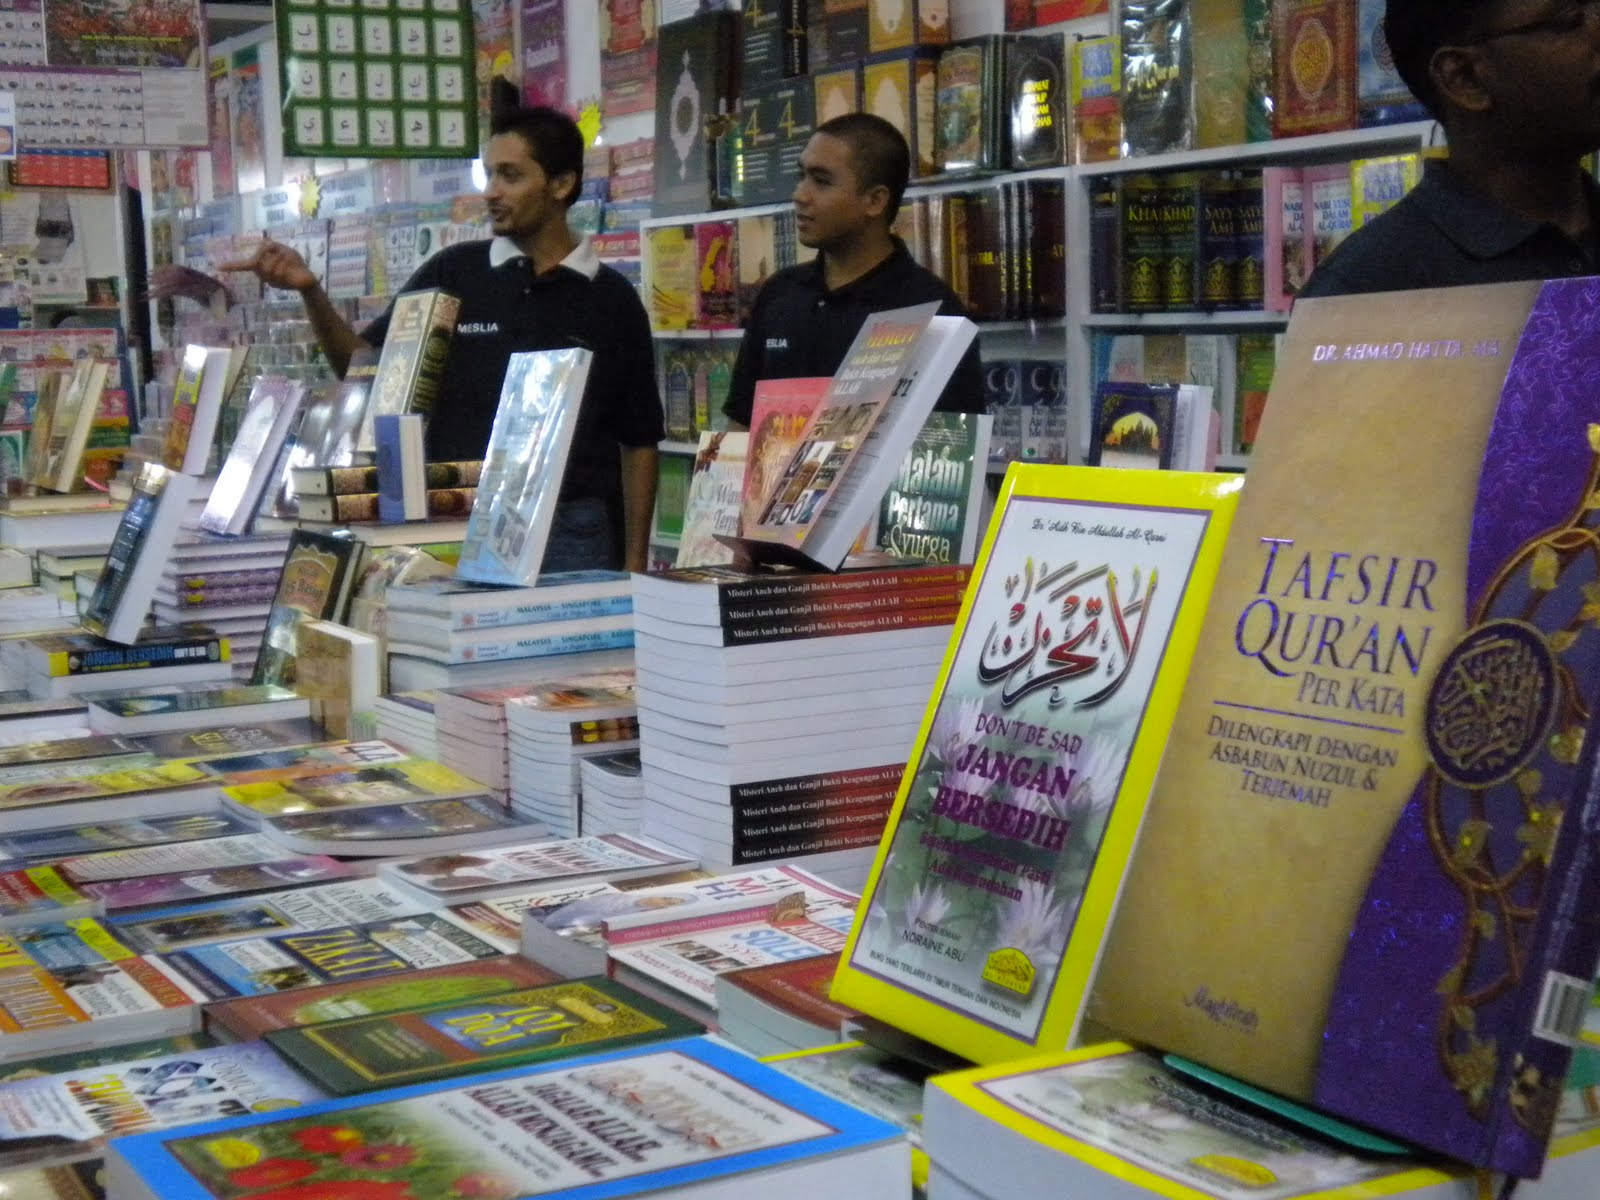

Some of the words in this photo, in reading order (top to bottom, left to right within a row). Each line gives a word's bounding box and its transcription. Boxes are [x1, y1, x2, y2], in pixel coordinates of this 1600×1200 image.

[1129, 205, 1158, 221] KHA
[1205, 206, 1232, 220] SAYY
[1210, 220, 1234, 234] AMI
[765, 339, 788, 348] ESLIA
[716, 482, 741, 503] Wan
[714, 508, 740, 533] Terp
[887, 490, 960, 533] Pertama
[887, 520, 951, 563] Syurga
[728, 588, 753, 598] Misteri
[755, 585, 772, 596] Aneh
[774, 585, 787, 594] dan
[788, 582, 811, 594] Ganjil
[812, 581, 831, 591] Bukti
[832, 579, 870, 591] Keagungan
[870, 576, 898, 588] ALLAH
[1257, 537, 1438, 612] TAFSIR
[729, 608, 755, 619] Misteri
[756, 606, 774, 617] Aneh
[775, 606, 789, 616] dan
[790, 603, 813, 615] Ganjil
[813, 602, 832, 612] Bukti
[833, 599, 872, 611] Keagungan
[873, 596, 900, 607] ALLAH
[733, 627, 759, 638] Misteri
[761, 625, 779, 636] Aneh
[780, 625, 793, 634] dan
[794, 621, 816, 633] Ganjil
[818, 620, 836, 631] Bukti
[837, 618, 875, 630] Keagungan
[877, 615, 903, 626] ALLAH
[1235, 598, 1432, 678] QUR'AN
[1296, 671, 1342, 708] PER
[1345, 678, 1406, 718] KATA
[975, 713, 1026, 738] DON'T
[1024, 724, 1048, 747] BE
[1048, 730, 1083, 754] SAD
[1207, 715, 1313, 752] DILENGKAPI
[1316, 736, 1400, 767] DENGAN
[956, 743, 1077, 799] JANGAN
[1209, 740, 1290, 773] ASBABUN
[1292, 756, 1356, 788] NUZUL
[1362, 768, 1378, 791] &
[739, 786, 764, 797] Misteri
[765, 783, 784, 794] Aneh
[785, 783, 798, 792] dan
[799, 779, 822, 792] Ganjil
[822, 777, 841, 788] Bukti
[842, 773, 880, 785] Keagungan
[1241, 769, 1332, 808] TERJEMAH
[742, 806, 768, 817] Misteri
[770, 803, 787, 814] Aneh
[788, 803, 801, 812] dan
[802, 799, 824, 811] Ganjil
[826, 797, 845, 807] Bukti
[846, 793, 883, 804] Keagungan
[743, 826, 768, 837] Misteri
[770, 823, 787, 834] Aneh
[788, 823, 802, 832] dan
[803, 818, 825, 830] Ganjil
[826, 816, 845, 827] Bukti
[846, 812, 883, 823] Keagungan
[932, 784, 1072, 853] BERSEDIH
[741, 848, 766, 859] Misteri
[769, 845, 786, 856] Aneh
[787, 844, 800, 853] dan
[801, 840, 823, 852] Ganjil
[824, 838, 843, 848] Bukti
[901, 930, 944, 955] NORAINE
[945, 943, 967, 963] ABU
